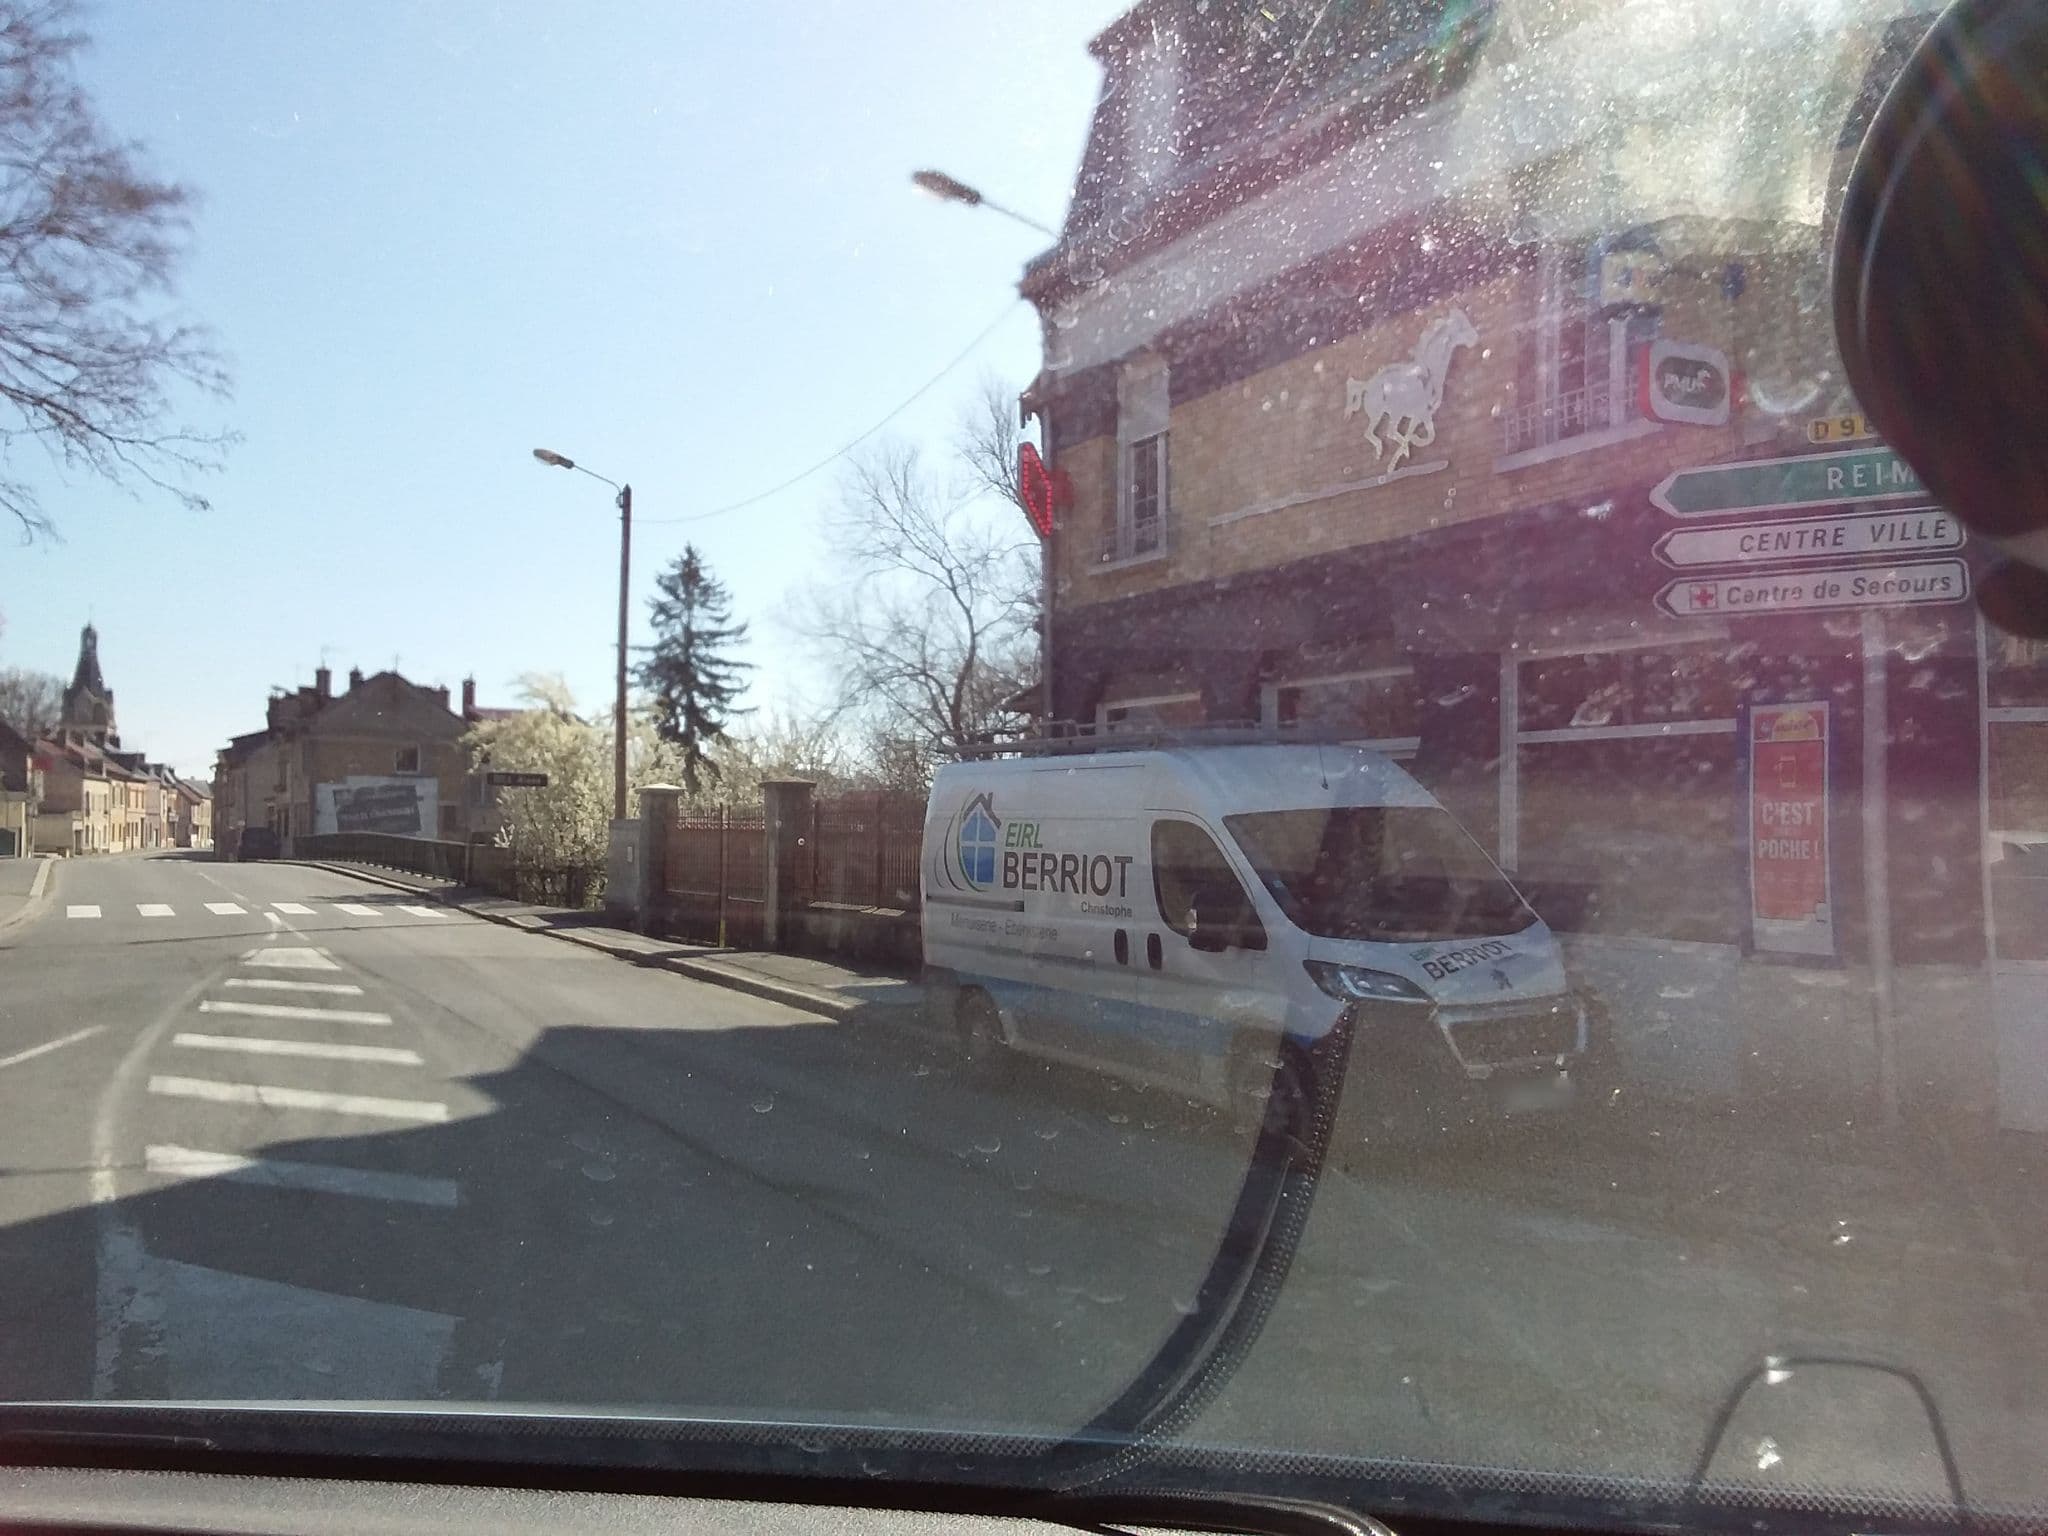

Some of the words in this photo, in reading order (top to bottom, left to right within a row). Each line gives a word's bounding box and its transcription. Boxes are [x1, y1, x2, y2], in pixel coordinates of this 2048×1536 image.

[1814, 421, 1830, 441] D
[1826, 459, 1916, 491] REIM
[1738, 525, 1847, 554] CENTRE
[1870, 518, 1949, 543] VILLE
[1726, 582, 1804, 605] Centre
[1813, 580, 1841, 598] de
[1851, 575, 1952, 596] Secours
[1005, 822, 1043, 849] EIRL
[1758, 838, 1811, 860] POCHE
[1003, 850, 1134, 898] BERRIOT
[1080, 899, 1133, 919] Christophe
[1421, 940, 1513, 980] BERRIOT
